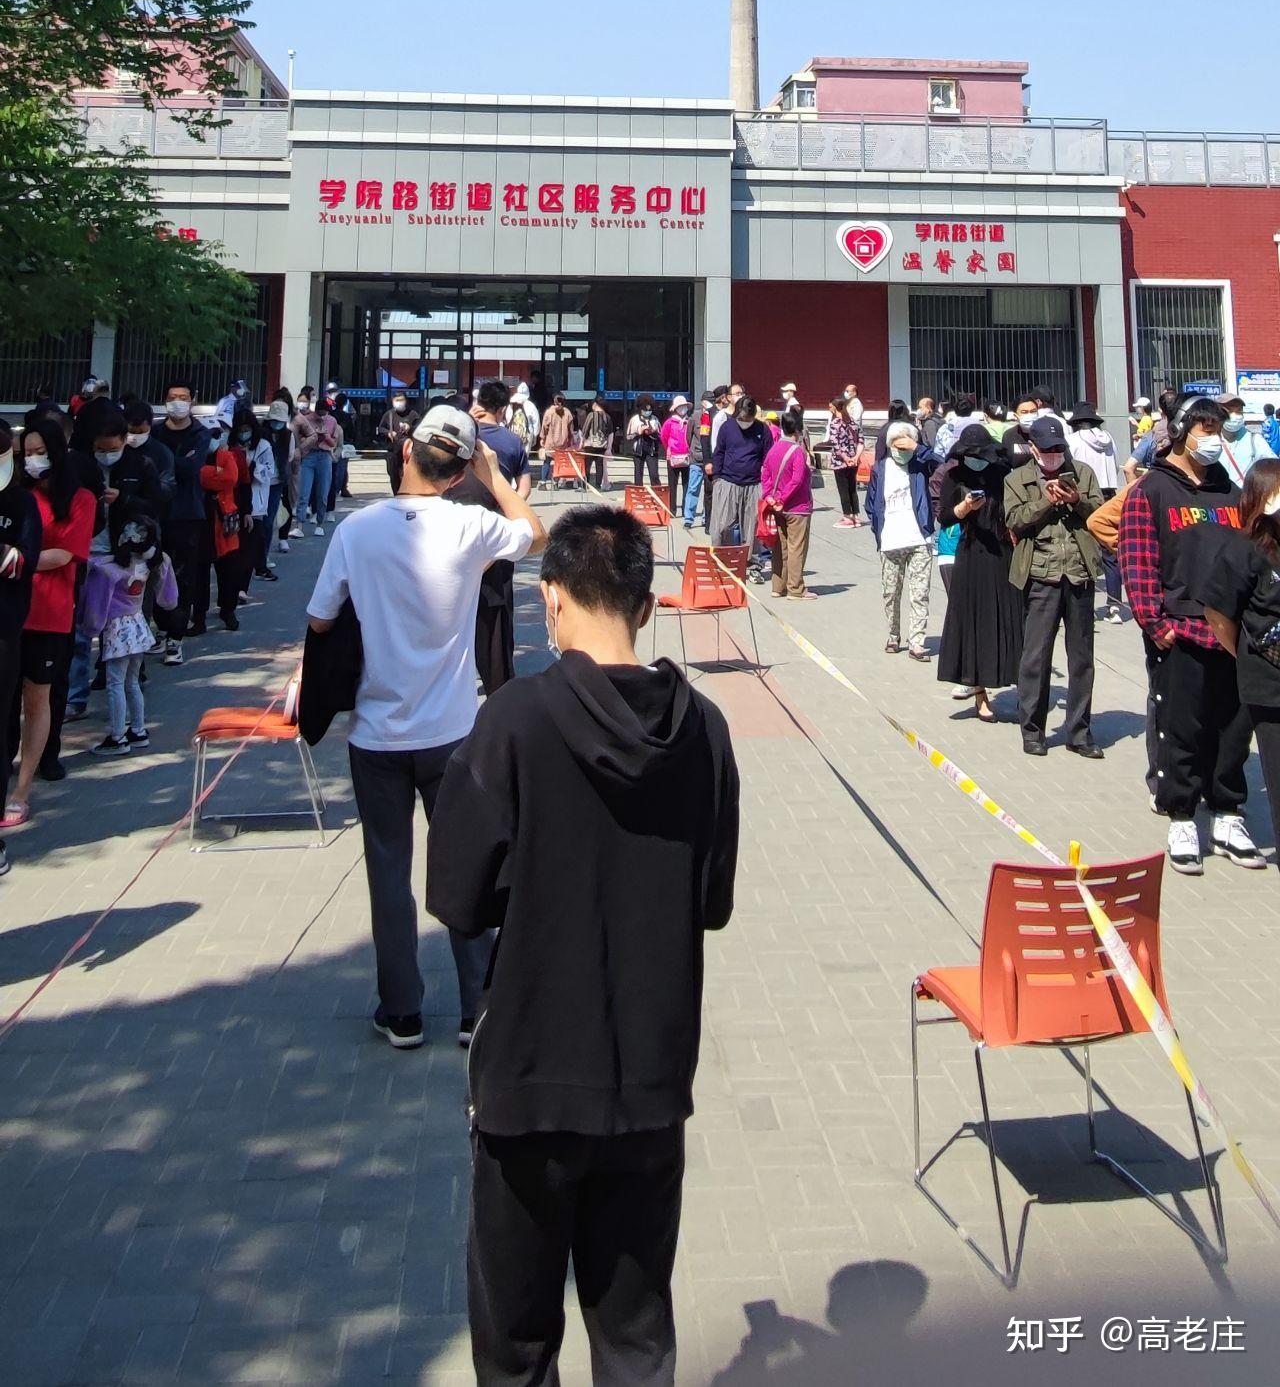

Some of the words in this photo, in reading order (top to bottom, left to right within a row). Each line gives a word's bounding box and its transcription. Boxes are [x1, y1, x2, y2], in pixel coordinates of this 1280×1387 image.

[319, 179, 706, 215] 学院路街道社区服务中心
[318, 212, 393, 227] Xueyuanlu
[407, 213, 486, 227] Subdistrict
[500, 215, 578, 230] Community
[590, 217, 647, 230] Services
[659, 218, 705, 230] Center
[915, 223, 1005, 243] 学院路街道
